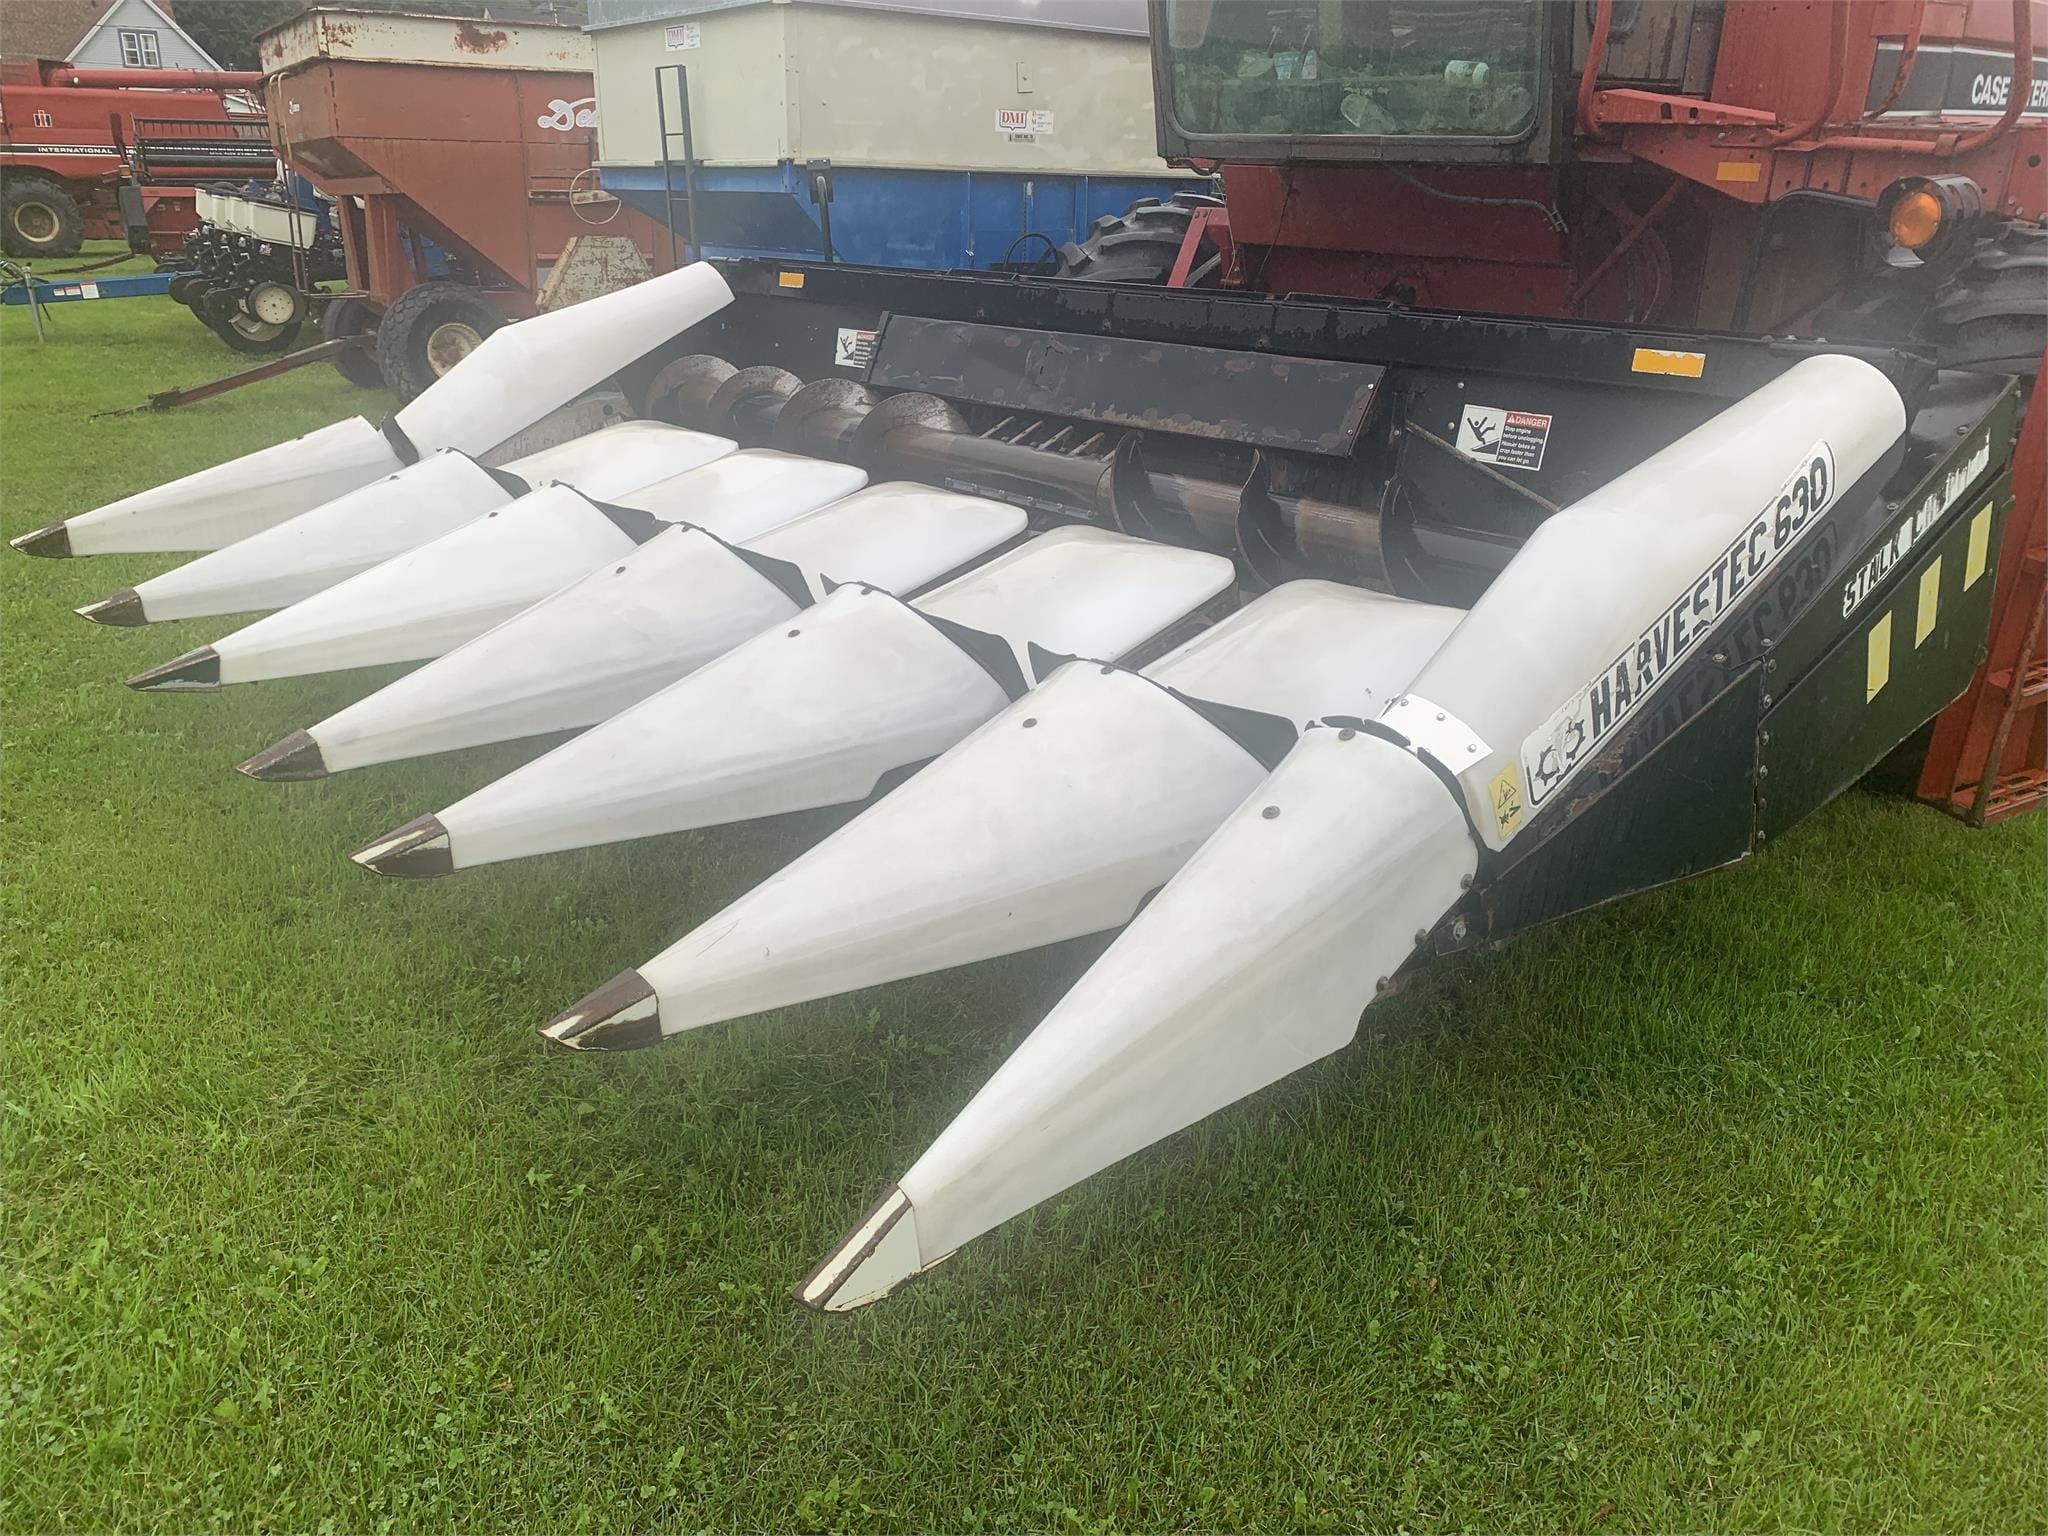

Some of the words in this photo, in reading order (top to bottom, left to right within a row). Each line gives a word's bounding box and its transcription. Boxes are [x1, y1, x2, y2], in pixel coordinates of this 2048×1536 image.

[1972, 74, 2011, 105] CASE
[537, 97, 599, 131] De
[1002, 112, 1024, 124] DMI
[1515, 416, 1548, 427] DANGER
[1844, 532, 1900, 616] STALK
[1590, 521, 1766, 740] HARVESTEC
[1774, 456, 1828, 550] 630
